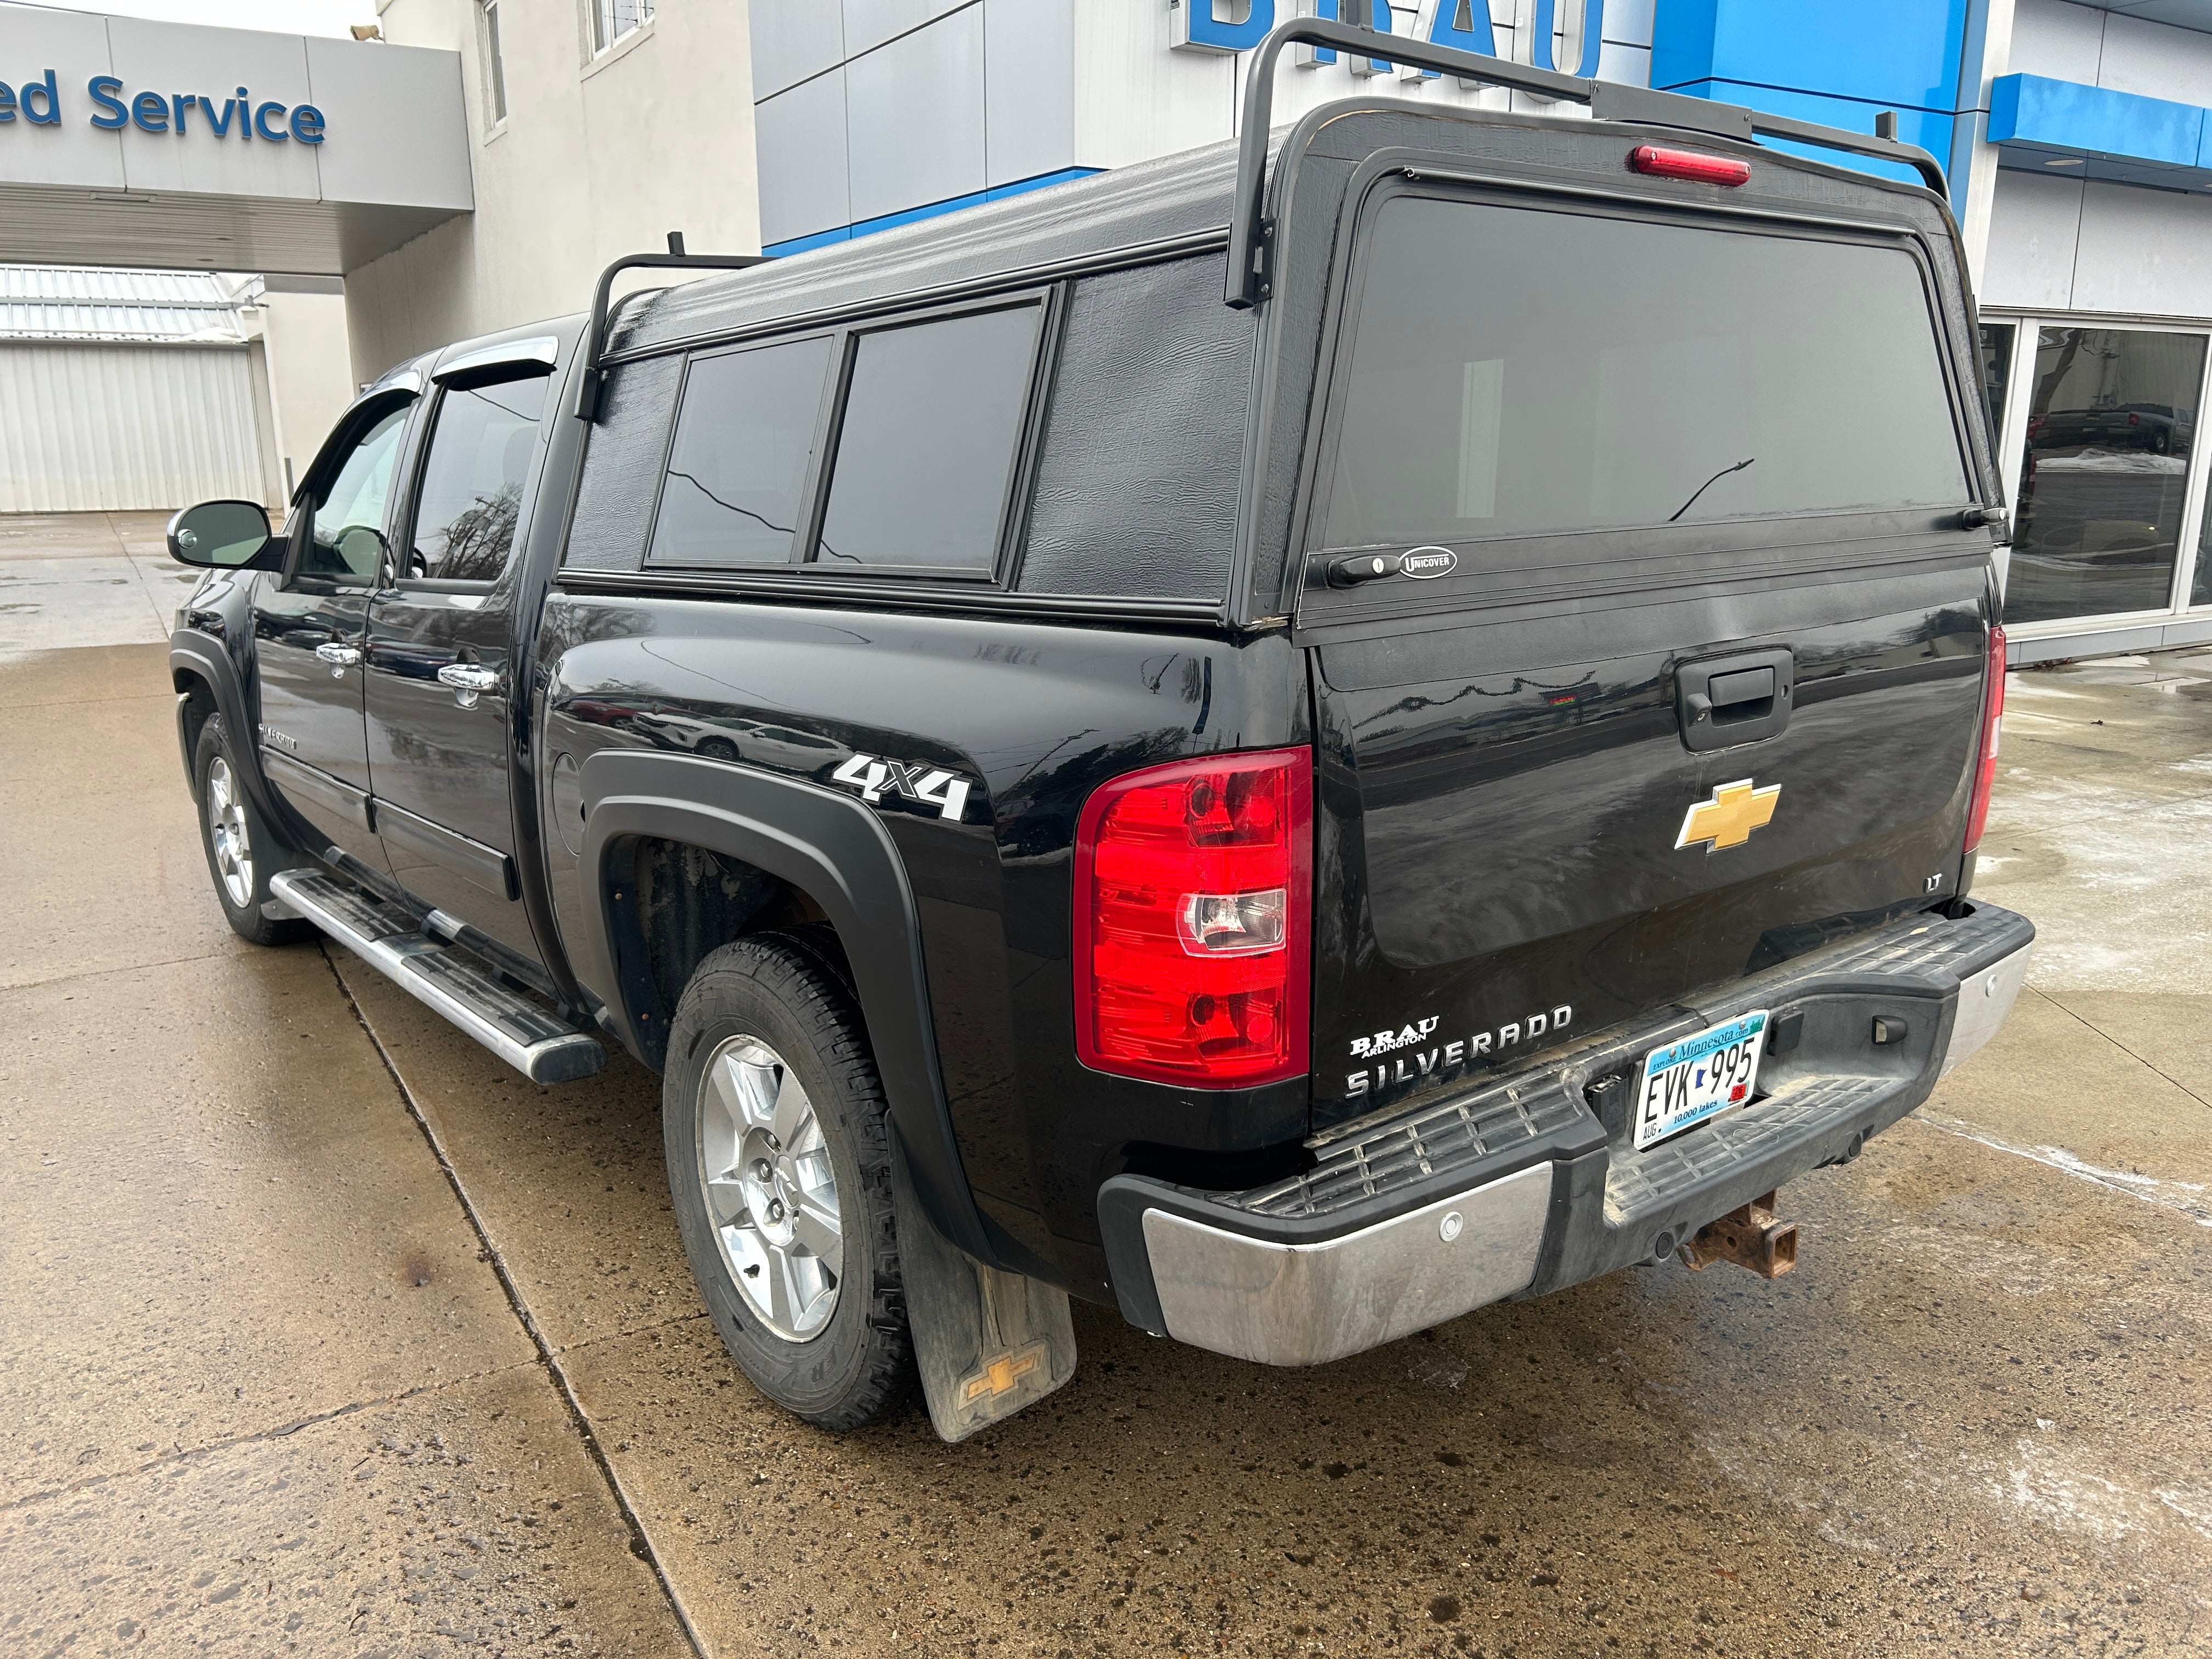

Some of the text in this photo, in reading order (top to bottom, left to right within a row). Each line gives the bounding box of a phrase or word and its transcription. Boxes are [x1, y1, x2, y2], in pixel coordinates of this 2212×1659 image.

[88, 75, 326, 145] Service
[1404, 554, 1449, 572] UNICOVER
[1924, 873, 1942, 894] LT
[1345, 1003, 1572, 1099] SILVERADO
[1350, 1015, 1440, 1056] BRAU
[1361, 1032, 1426, 1059] ARLINGTON
[1644, 1036, 1755, 1124] EVK 995
[1673, 1099, 1718, 1125] 10,000 lakes
